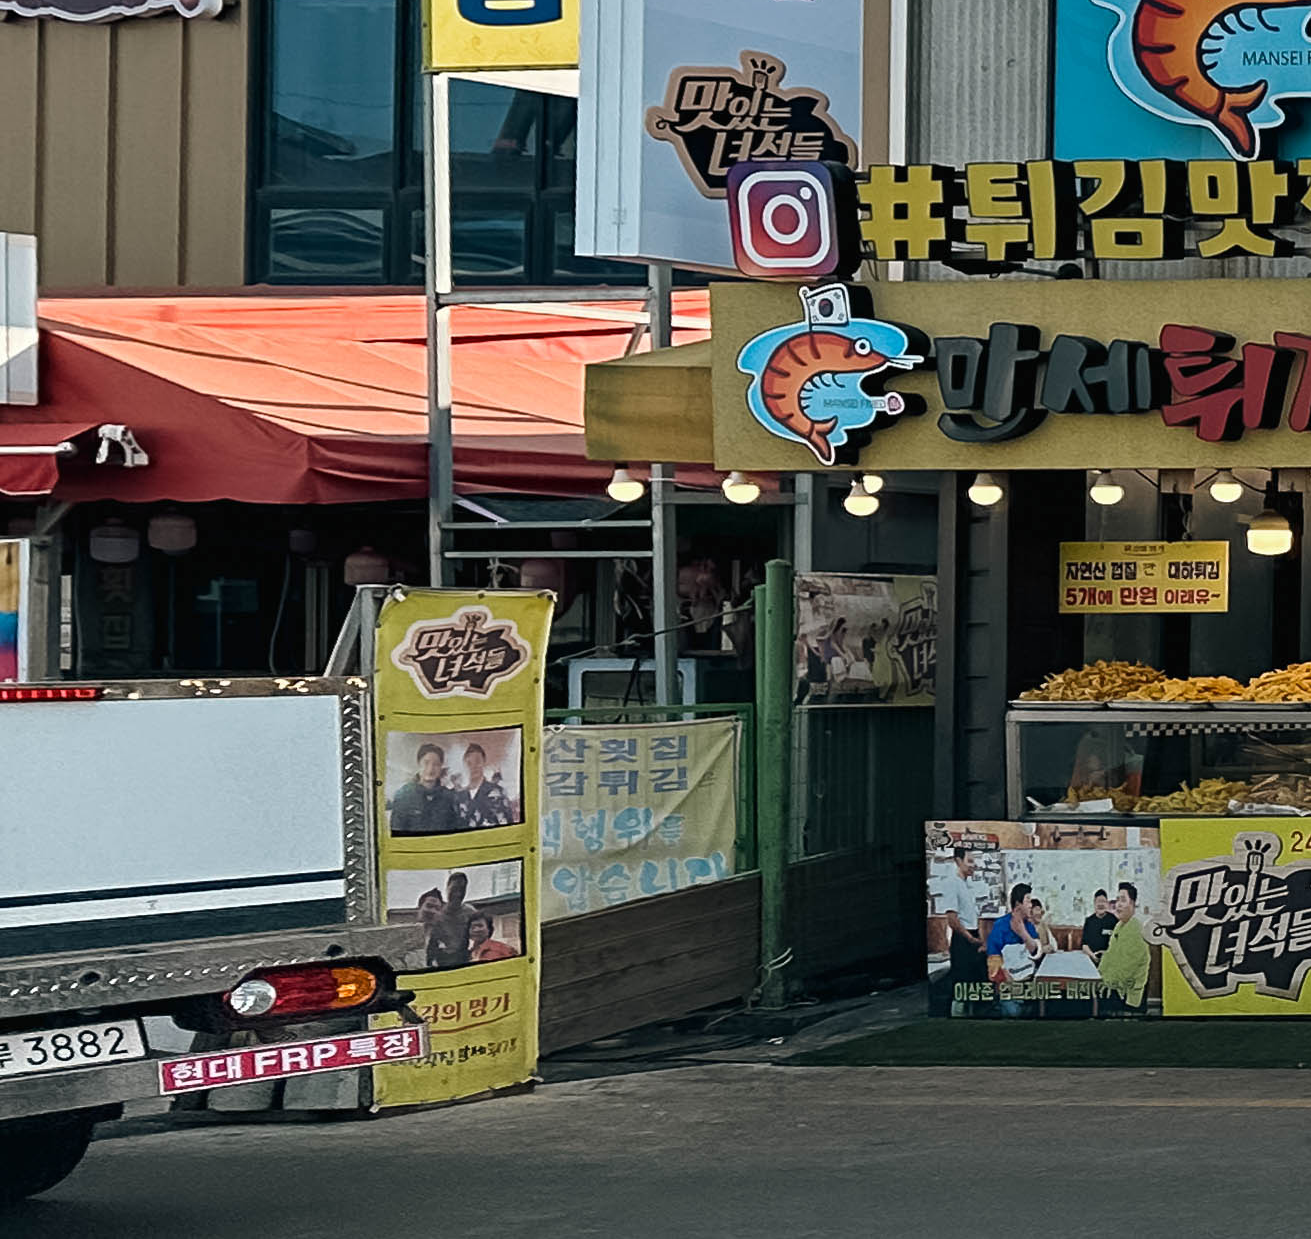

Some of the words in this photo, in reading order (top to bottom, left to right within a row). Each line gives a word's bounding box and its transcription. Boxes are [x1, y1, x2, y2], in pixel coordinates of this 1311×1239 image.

[1242, 50, 1303, 66] MANSEI
[675, 71, 793, 133] 맛있는
[1065, 561, 1107, 581] 자연산
[1110, 561, 1137, 581] 껍질
[1167, 560, 1220, 580] 대하튀김
[1065, 586, 1113, 606] 5개에
[1119, 586, 1158, 605] 만원
[415, 622, 489, 661] 맛있는
[433, 646, 506, 683] 녀석들
[1169, 851, 1288, 936] 맛있는
[414, 1001, 462, 1024] 김의
[468, 992, 512, 1019] 명가
[953, 981, 995, 1001] 이상준
[22, 1025, 129, 1067] 3882
[170, 1058, 243, 1087] 현대
[254, 1046, 337, 1076] FRP
[345, 1030, 414, 1062] 특장
